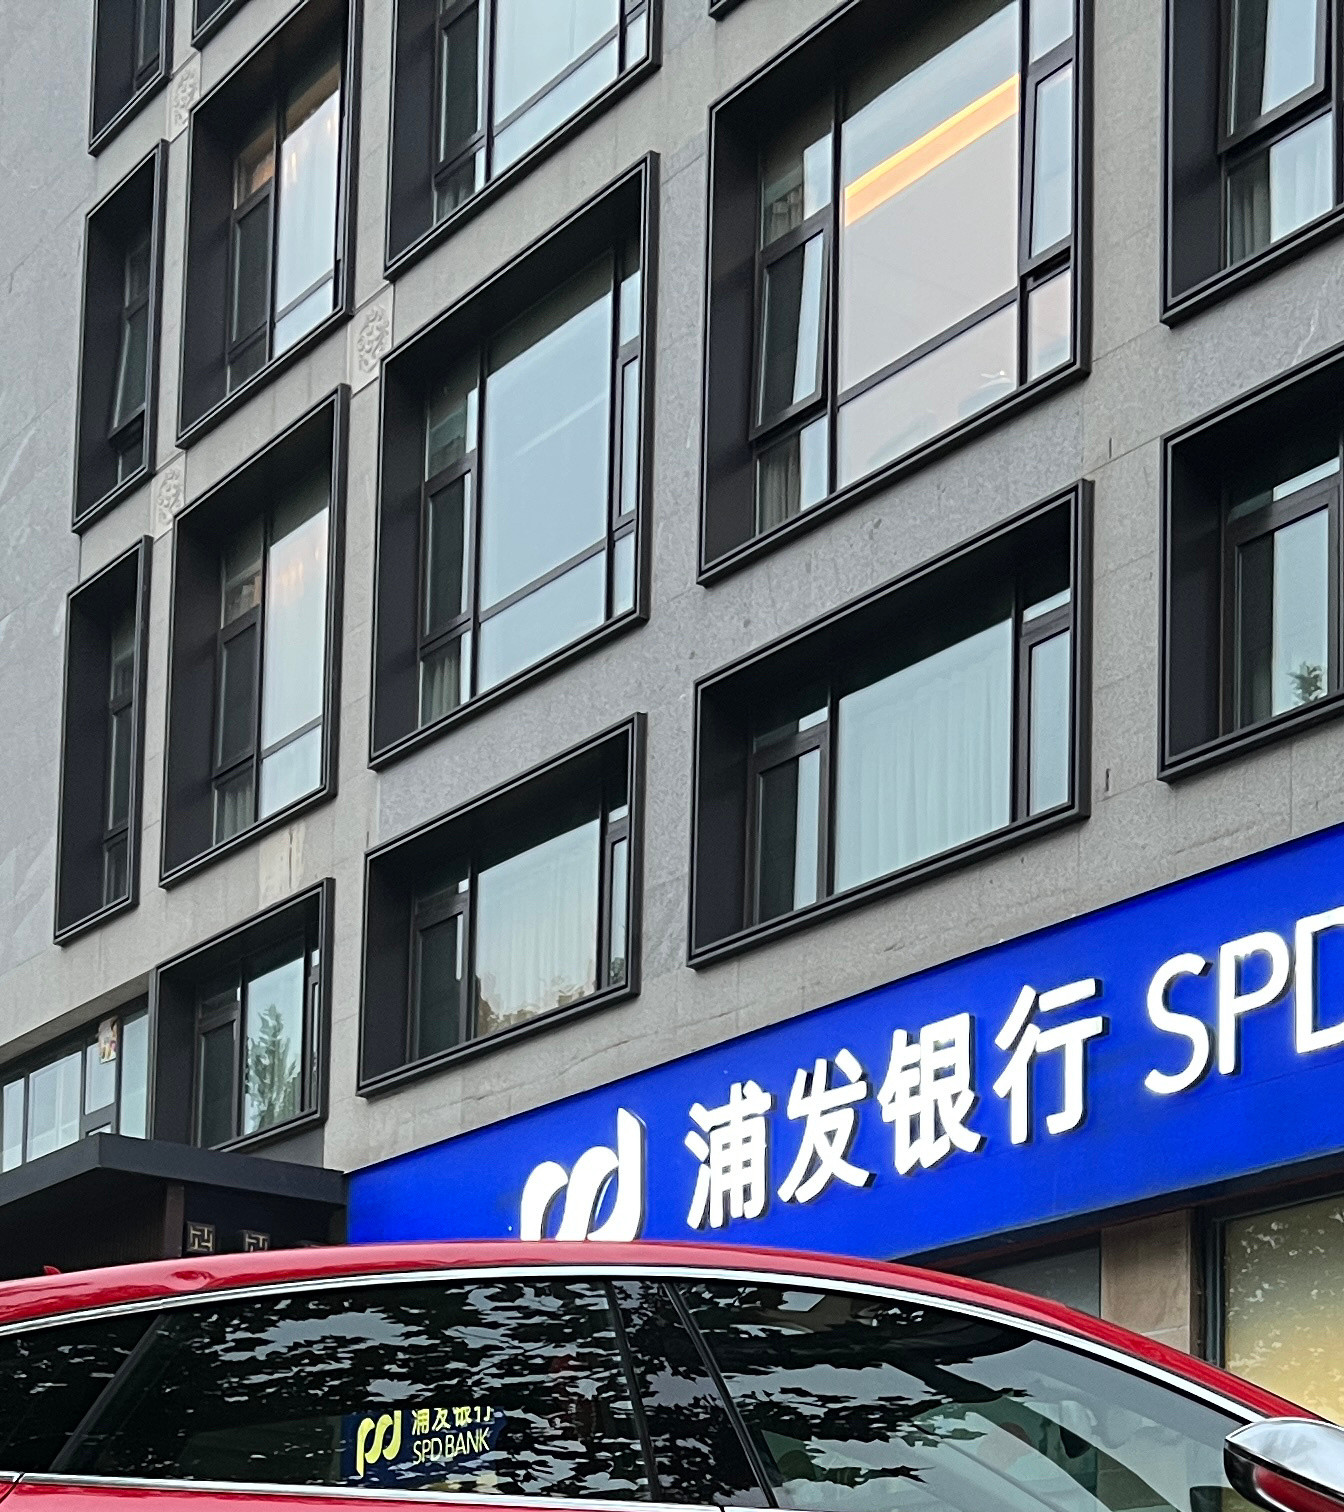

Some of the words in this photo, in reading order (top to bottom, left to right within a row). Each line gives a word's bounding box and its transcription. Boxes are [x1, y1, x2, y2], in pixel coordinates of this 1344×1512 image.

[684, 976, 1106, 1230] 浦发银行
[412, 1437, 443, 1466] SPD
[445, 1427, 490, 1459] BANK
